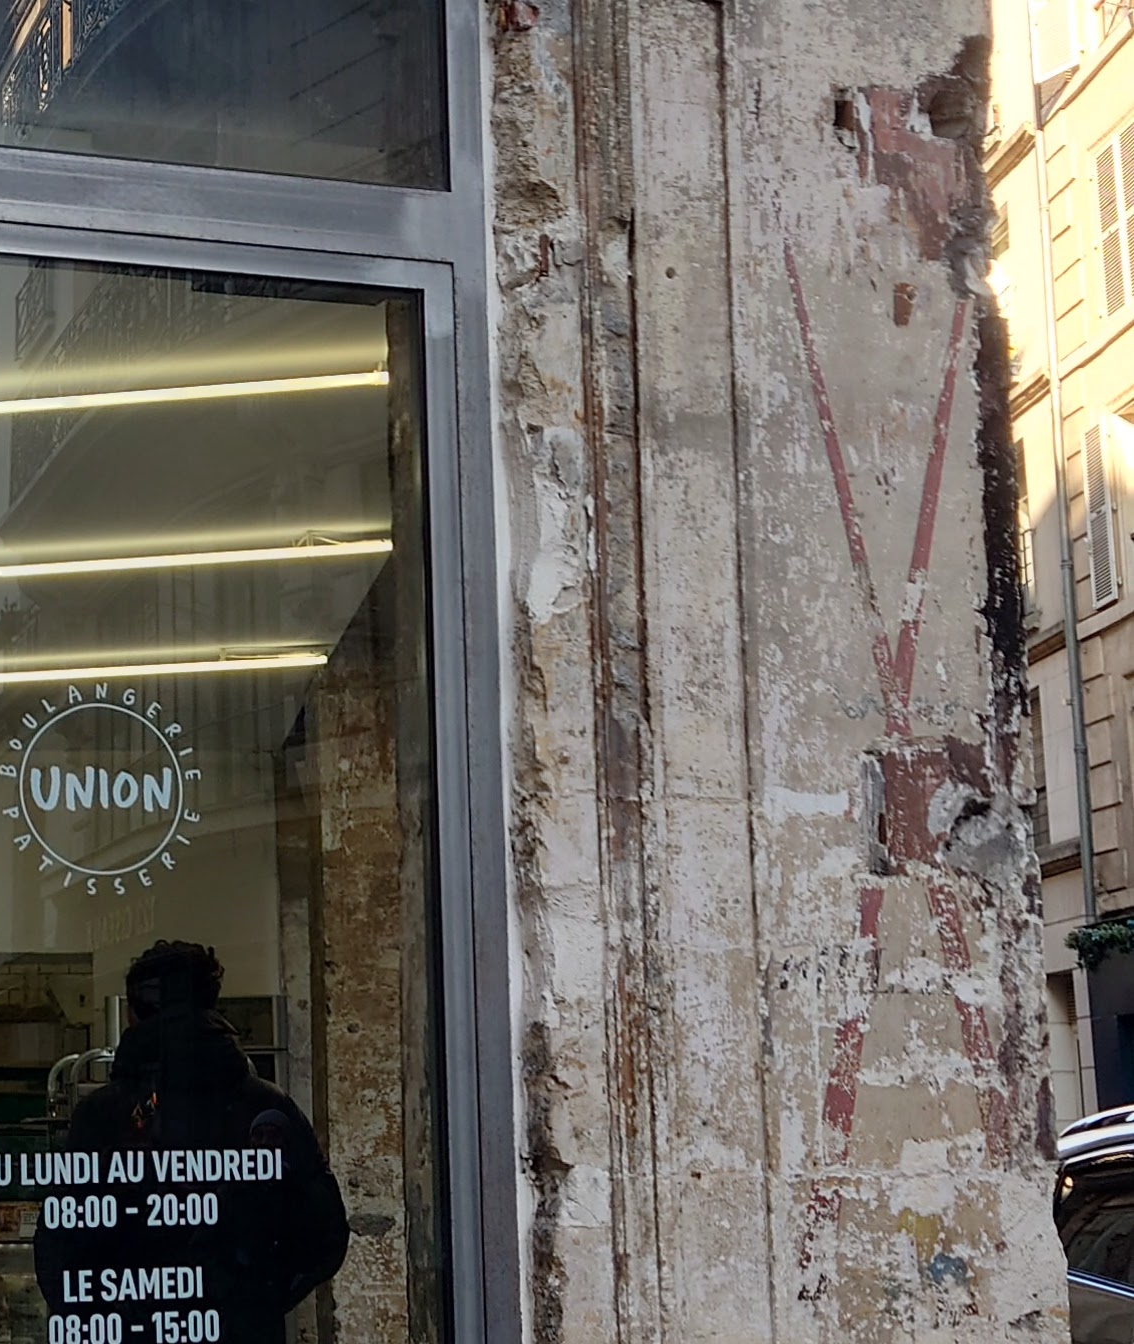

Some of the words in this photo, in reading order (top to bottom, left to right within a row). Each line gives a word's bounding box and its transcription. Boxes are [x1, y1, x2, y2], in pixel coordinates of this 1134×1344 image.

[30, 766, 172, 812] UNION
[2, 807, 200, 895] PATISSERIE
[19, 1151, 100, 1186] LUNDI
[107, 1150, 145, 1184] AU
[151, 1147, 283, 1183] VENDREDI
[43, 1194, 118, 1229] 08:00
[146, 1192, 219, 1227] 20:00
[62, 1268, 94, 1304] LE
[99, 1265, 204, 1302] SAMEDI
[151, 1309, 221, 1344] 15:00
